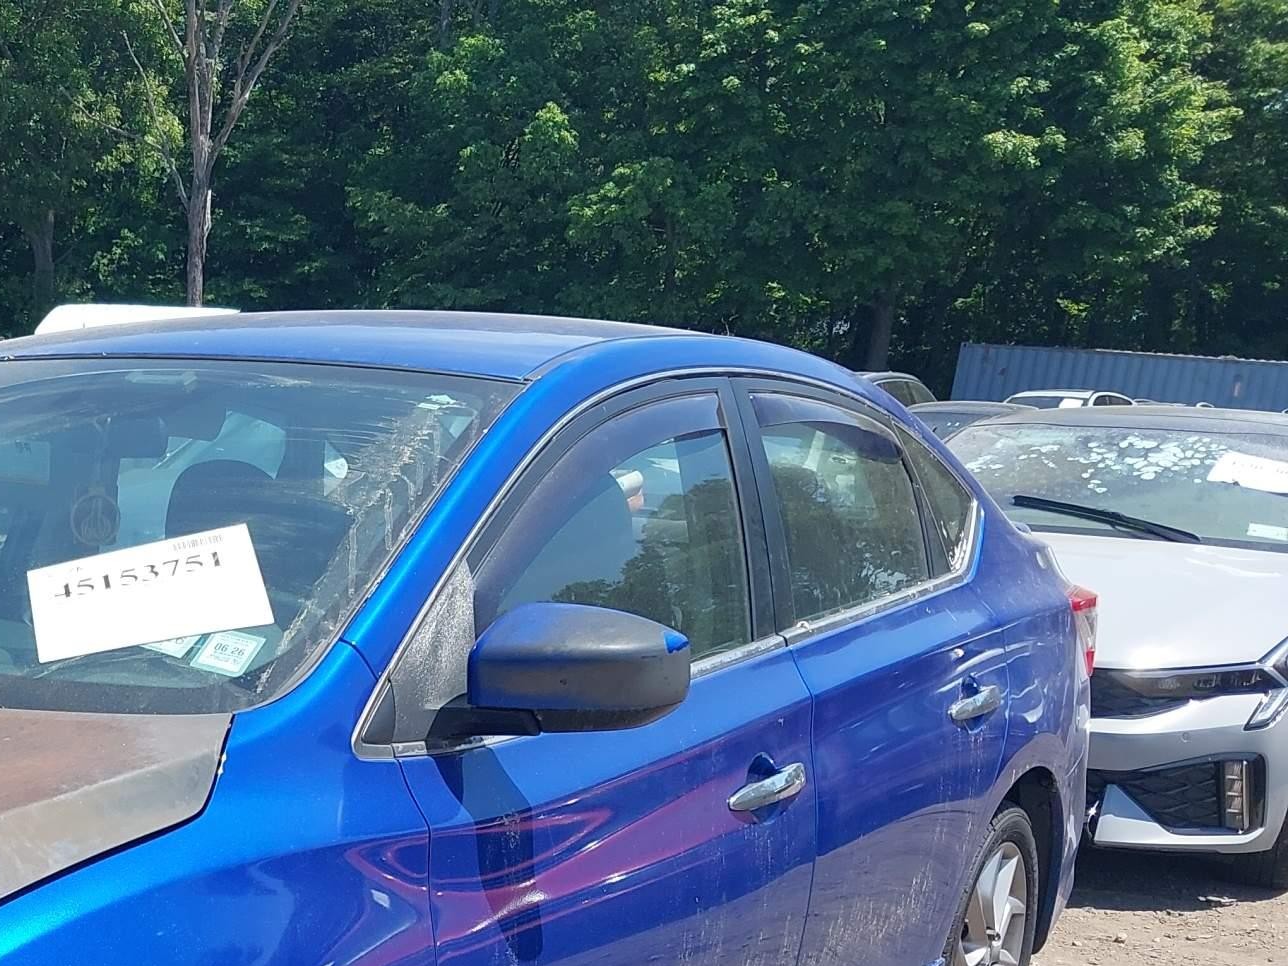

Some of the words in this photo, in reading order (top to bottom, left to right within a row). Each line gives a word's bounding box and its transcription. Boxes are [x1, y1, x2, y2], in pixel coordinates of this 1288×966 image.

[53, 551, 222, 598] 45153751
[214, 642, 228, 652] 06
[230, 647, 245, 657] 26
